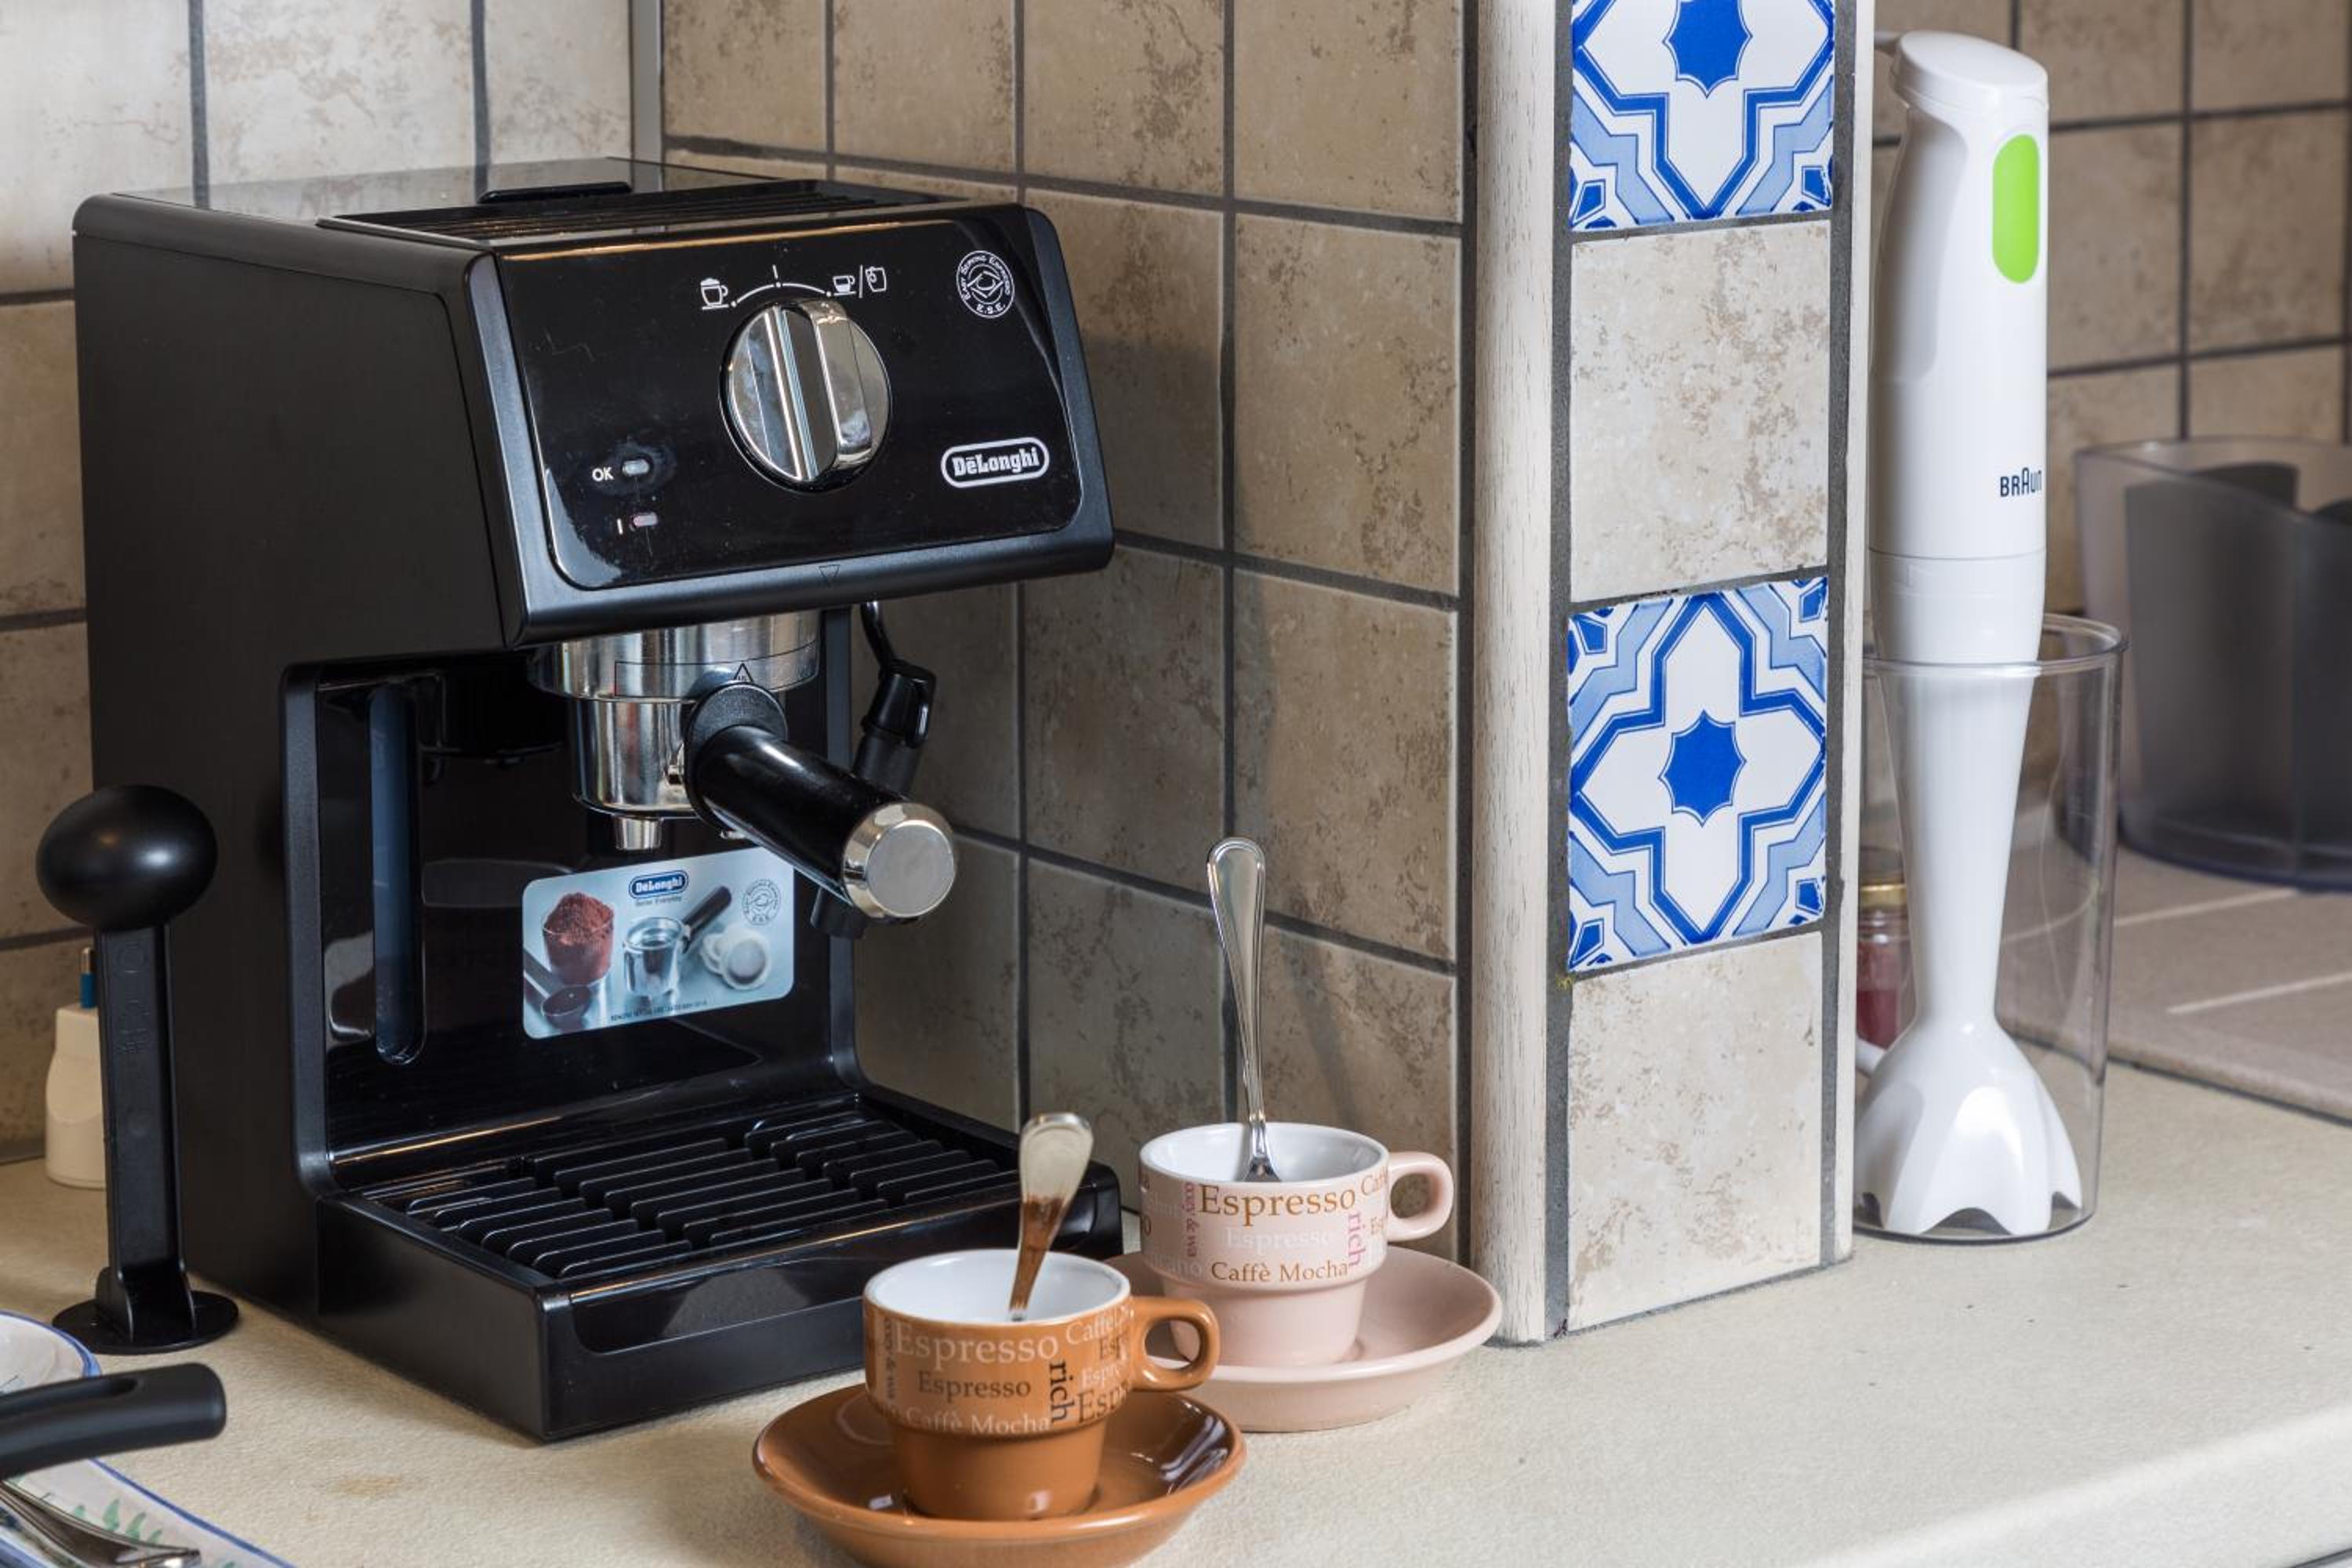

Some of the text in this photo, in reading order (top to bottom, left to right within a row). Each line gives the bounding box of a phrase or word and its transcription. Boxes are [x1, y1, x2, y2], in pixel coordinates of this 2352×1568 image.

[592, 466, 614, 481] OK
[1197, 1184, 1356, 1228] Espresso
[1348, 1210, 1367, 1268] rich
[1211, 1261, 1271, 1283] Caffè
[1279, 1259, 1349, 1282] Mocha
[896, 1320, 1059, 1371] Espresso
[919, 1369, 1033, 1404] Espresso
[1050, 1359, 1075, 1424] rich
[971, 1413, 1052, 1434] Mocha
